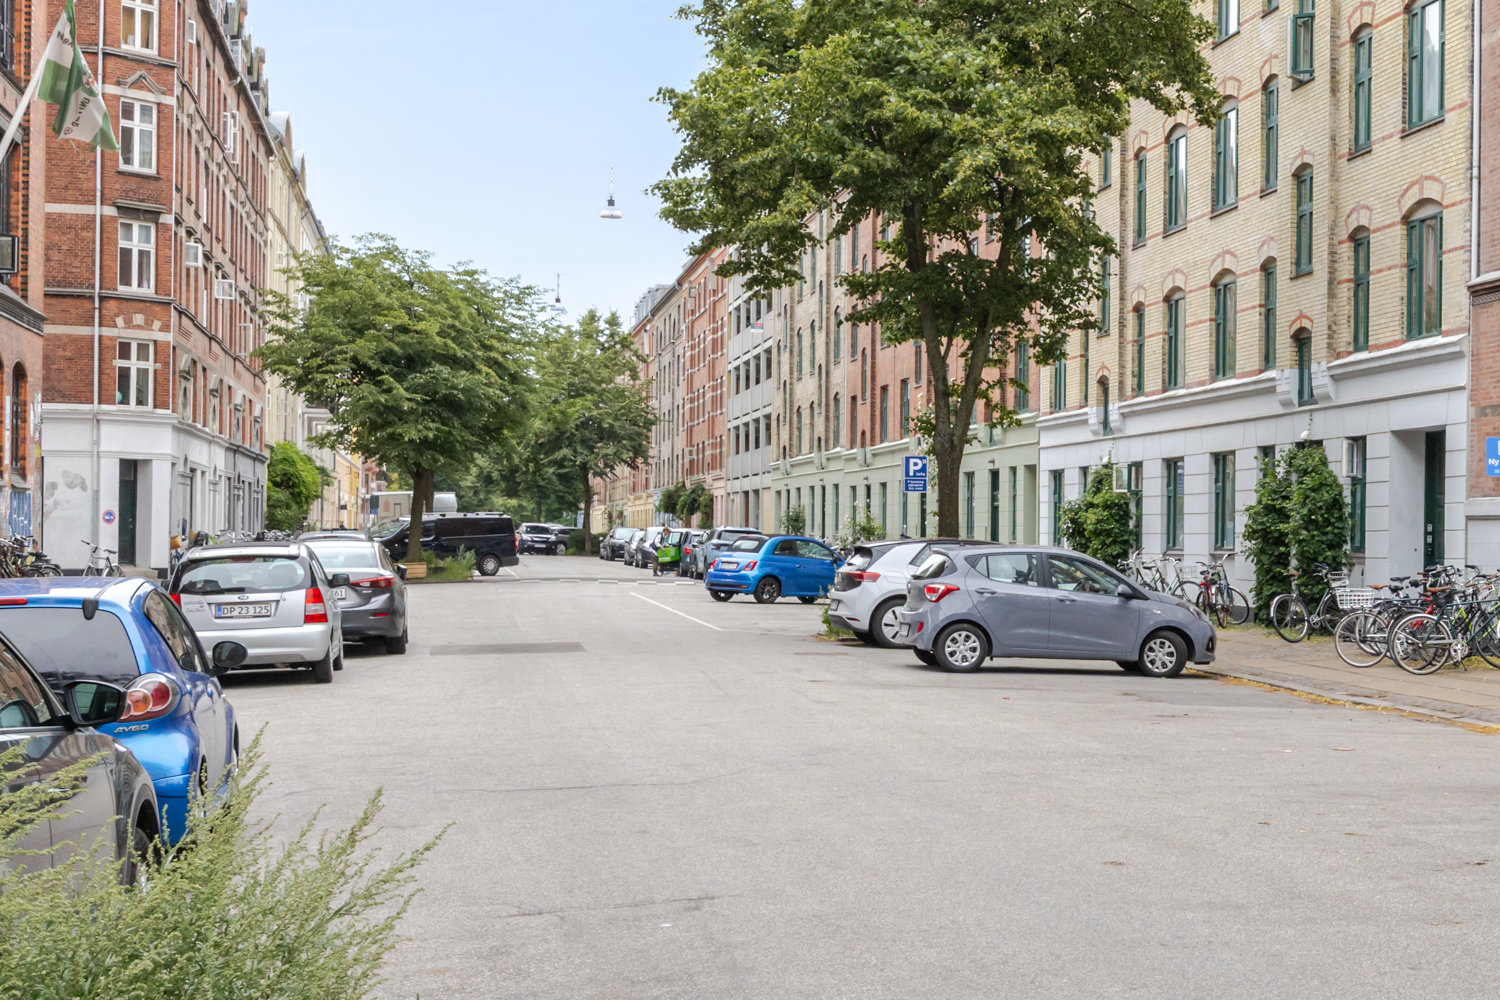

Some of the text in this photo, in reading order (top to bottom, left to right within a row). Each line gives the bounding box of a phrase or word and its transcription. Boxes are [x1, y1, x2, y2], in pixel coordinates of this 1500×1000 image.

[909, 458, 923, 476] P
[1488, 458, 1500, 467] Ny
[222, 605, 270, 615] DP 23 125
[113, 723, 150, 734] AYGO
